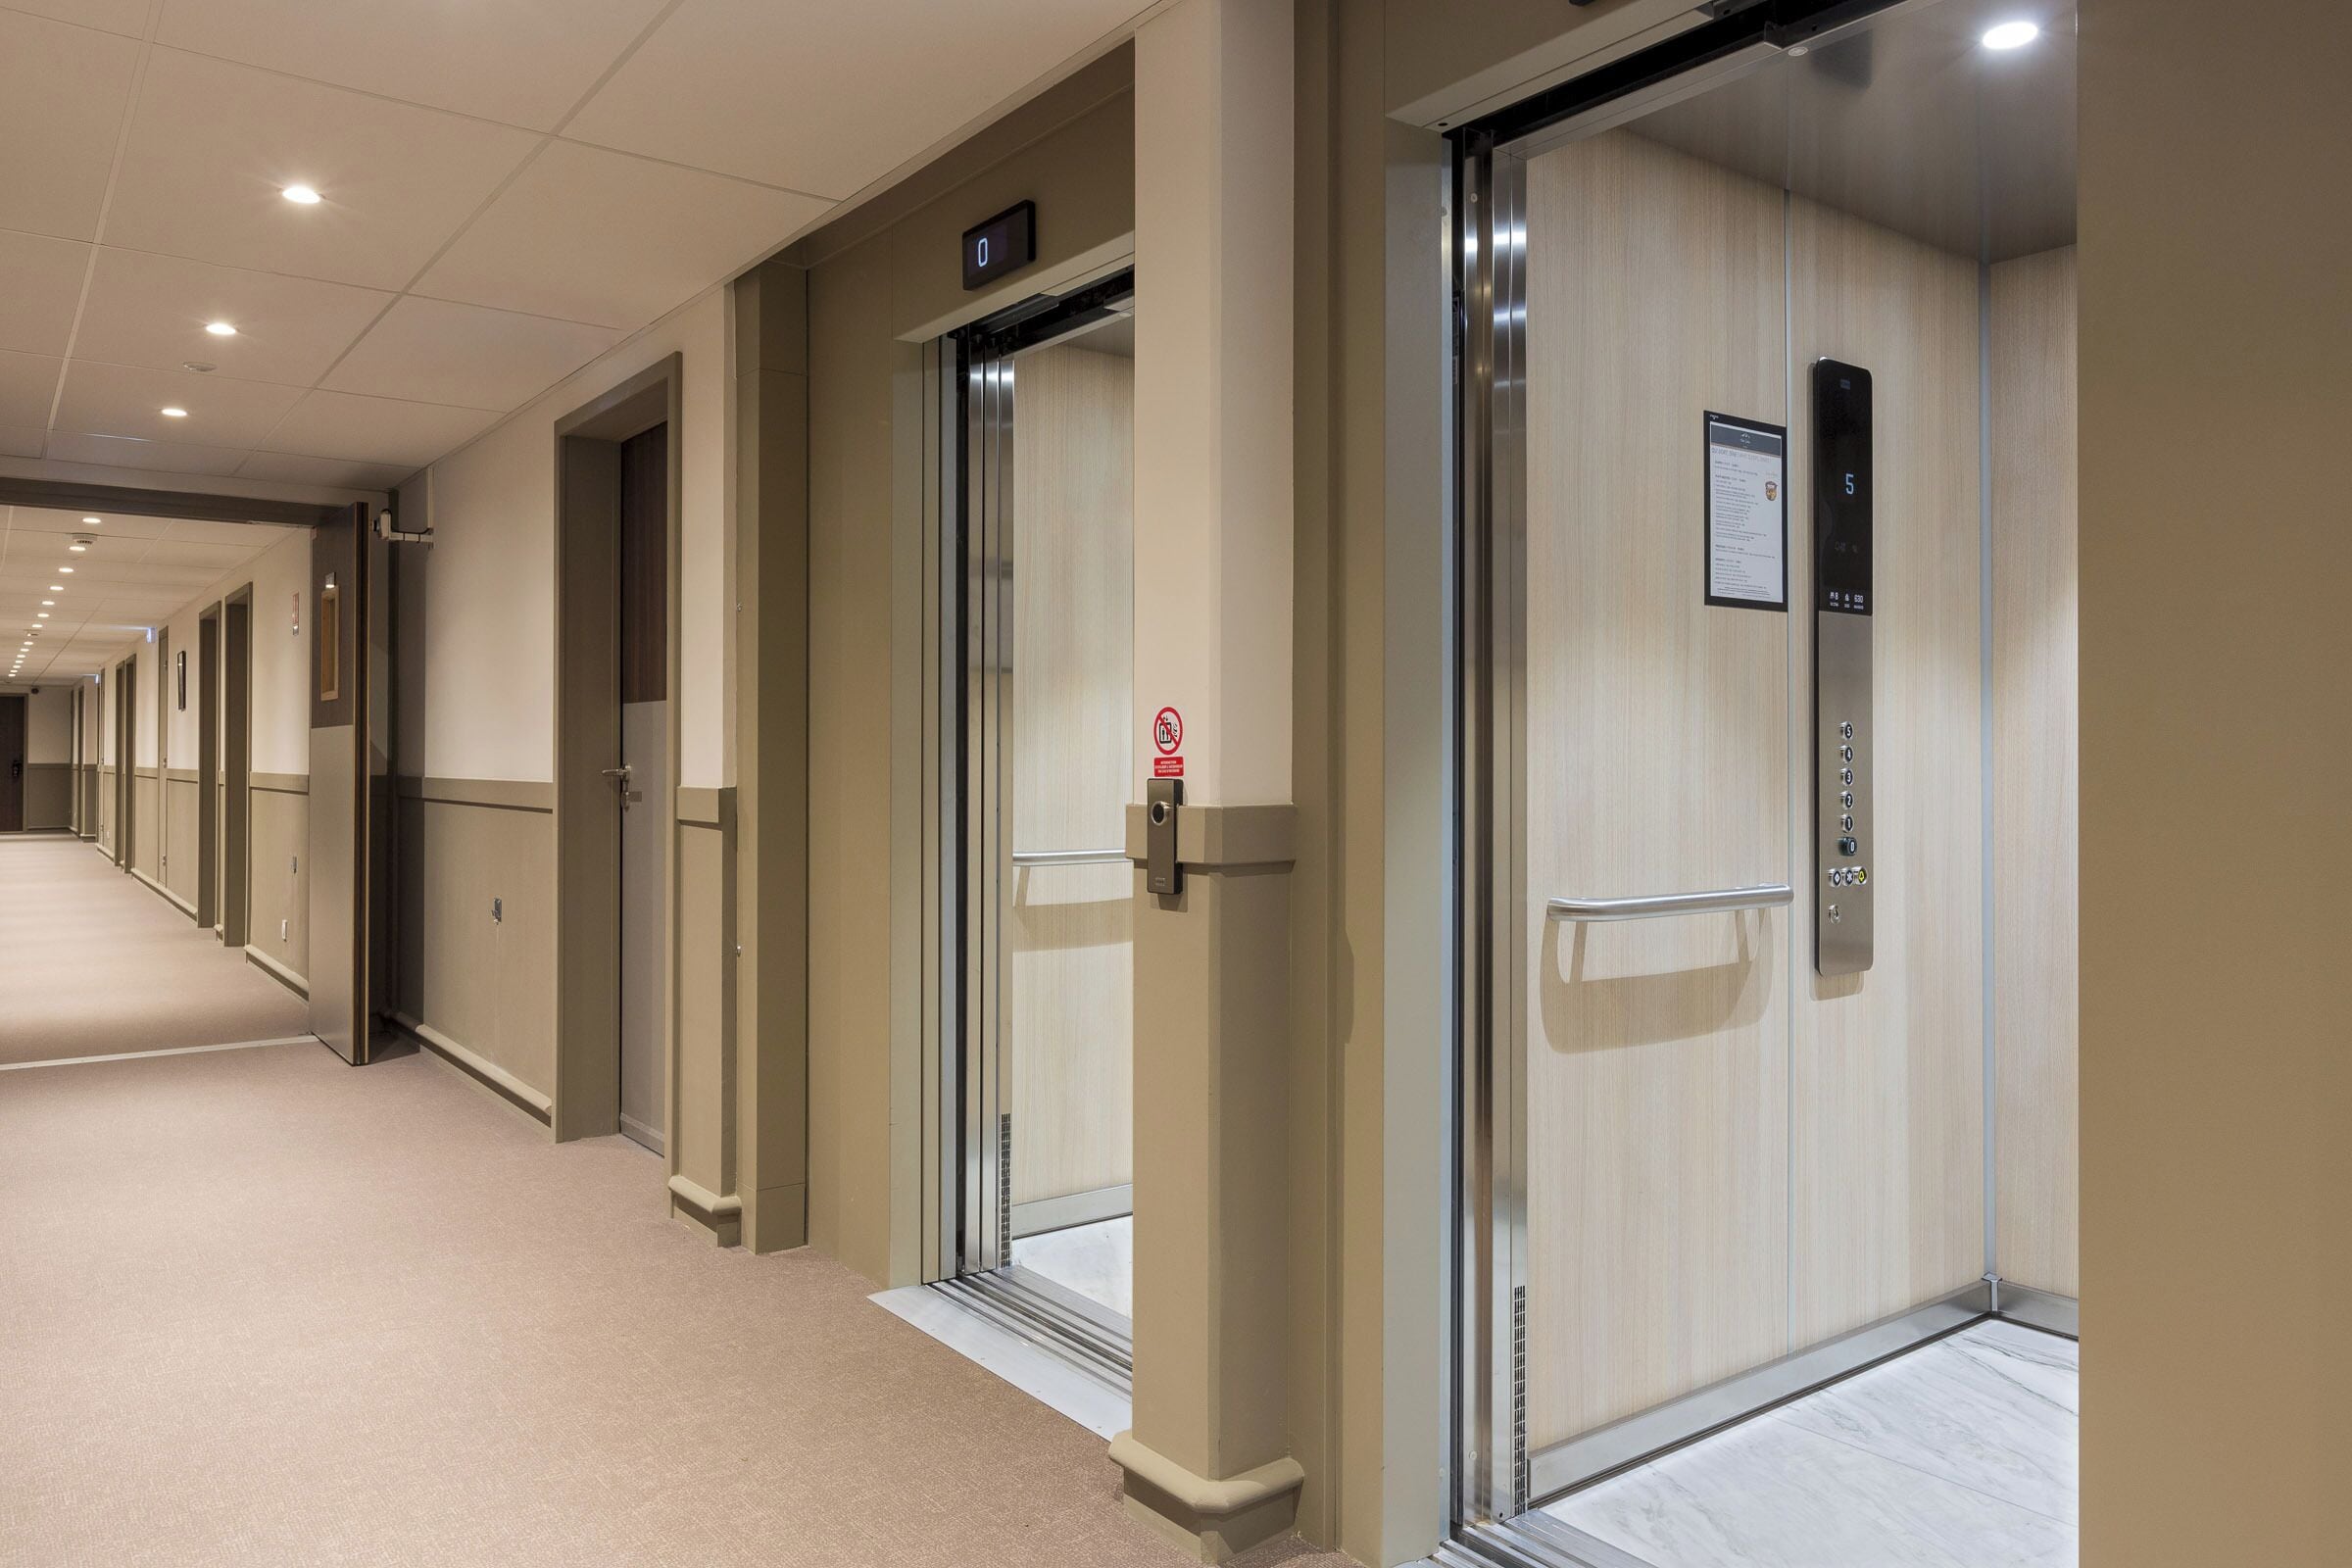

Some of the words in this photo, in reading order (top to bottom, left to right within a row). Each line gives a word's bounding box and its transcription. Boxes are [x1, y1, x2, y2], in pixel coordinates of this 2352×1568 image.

[978, 237, 988, 267] 0
[1845, 473, 1854, 495] 5
[1846, 726, 1851, 736] 5
[1846, 772, 1851, 783] 3
[1846, 795, 1851, 807] 2
